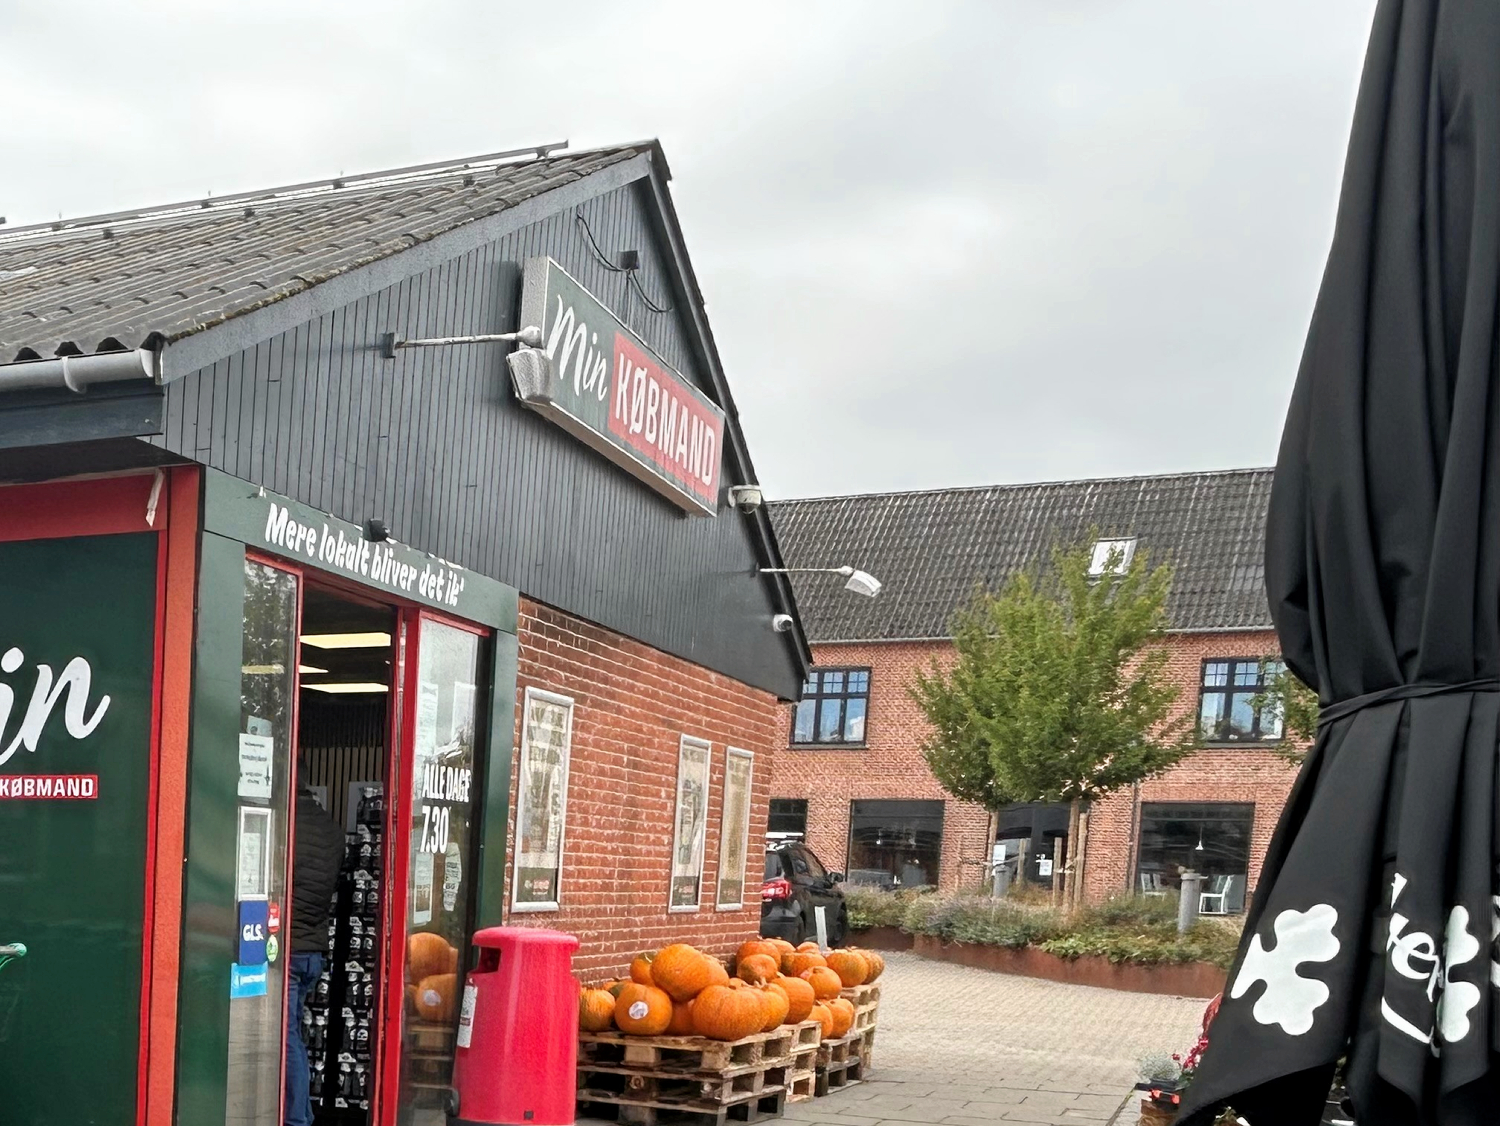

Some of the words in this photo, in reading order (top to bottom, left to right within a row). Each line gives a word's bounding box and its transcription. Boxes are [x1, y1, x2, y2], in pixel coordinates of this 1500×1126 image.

[547, 294, 608, 401] Min
[615, 353, 716, 487] KØBMAND
[265, 503, 317, 557] Mere
[318, 522, 370, 577] lokalt
[371, 544, 418, 591] bliver
[419, 563, 444, 602] det
[422, 763, 446, 800] ALLE
[446, 766, 472, 803] DAGE
